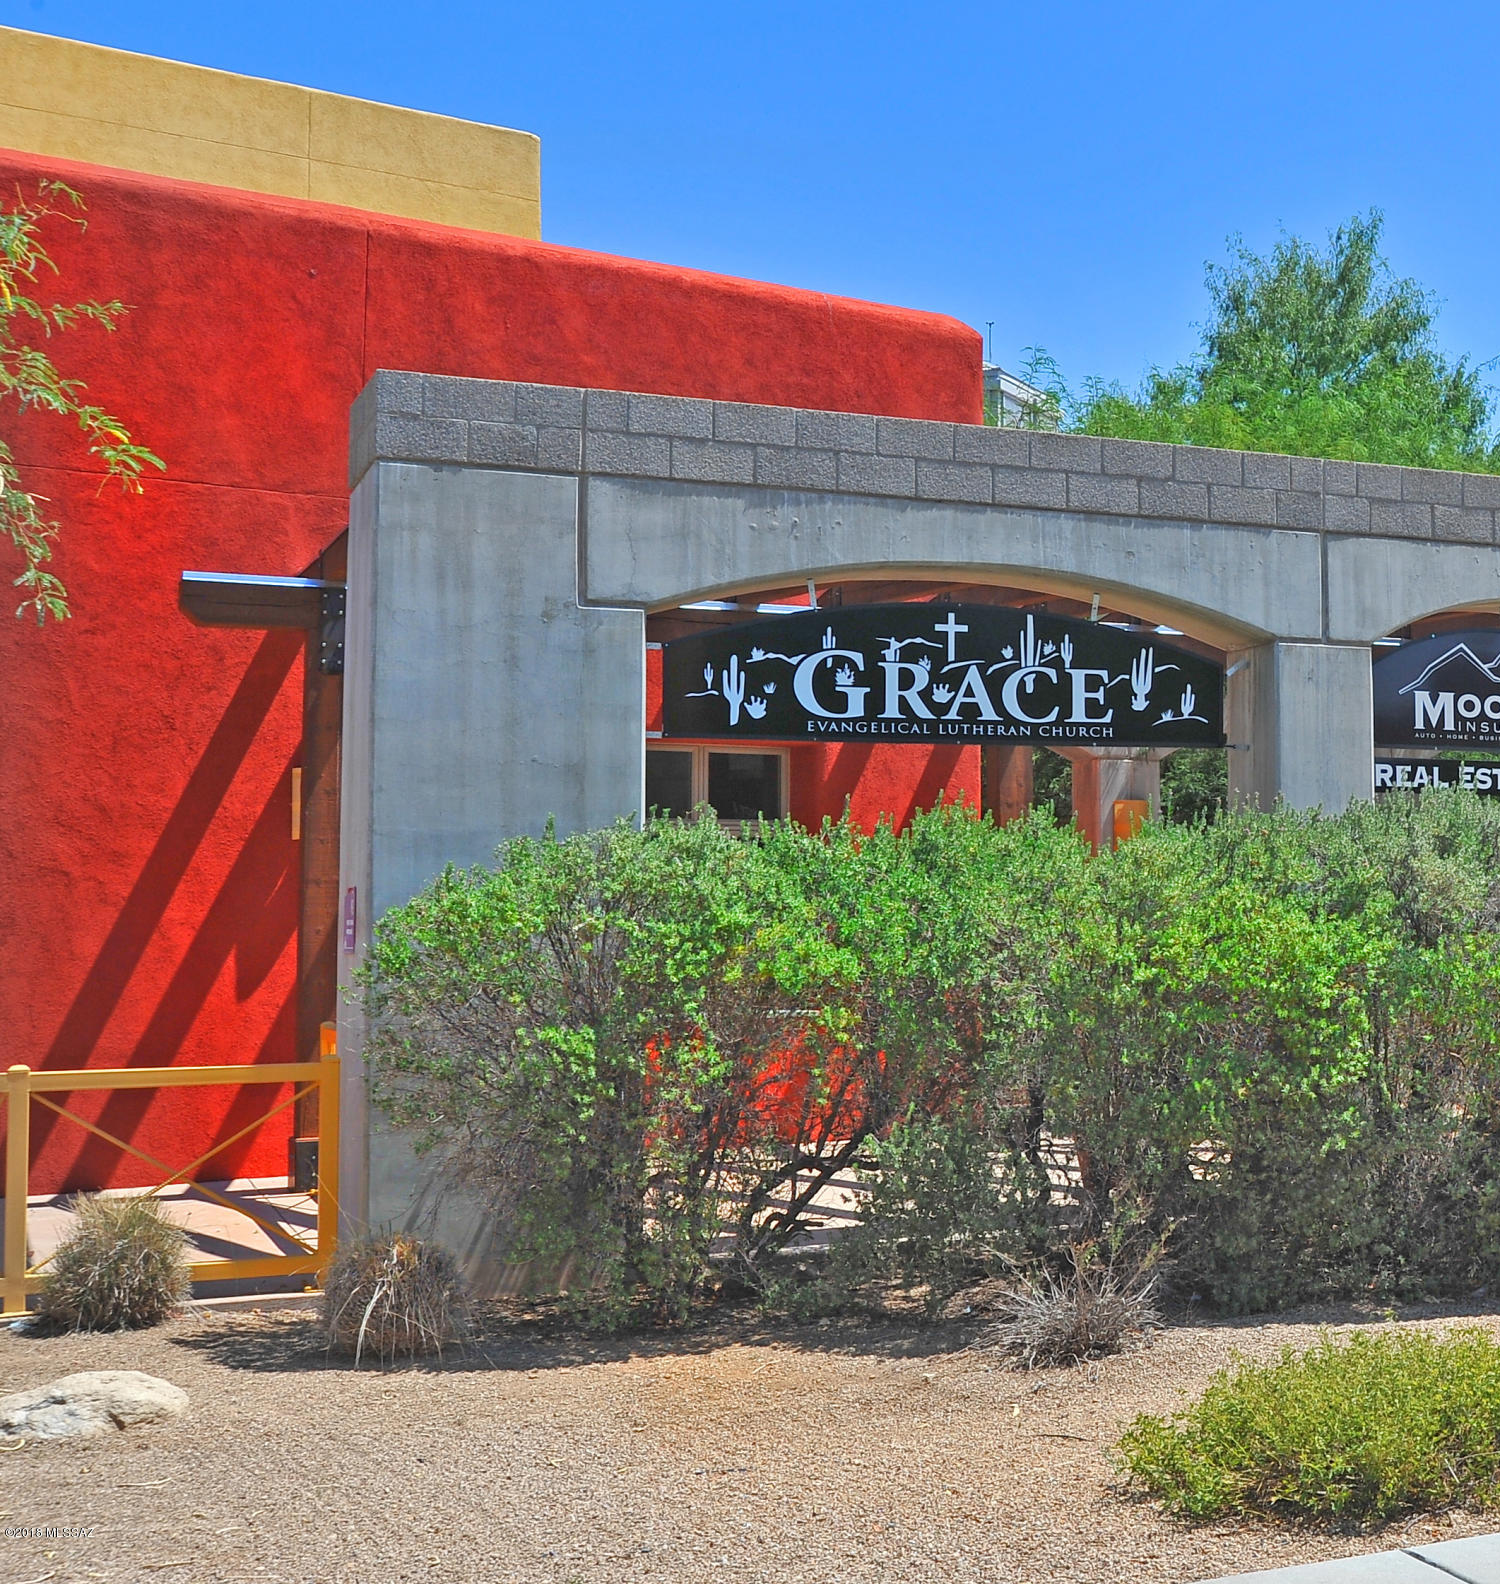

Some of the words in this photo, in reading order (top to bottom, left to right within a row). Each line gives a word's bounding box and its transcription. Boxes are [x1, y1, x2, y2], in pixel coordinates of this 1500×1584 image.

[793, 650, 1114, 724] GRACE
[807, 721, 930, 734] EVANGELICAL
[939, 723, 1032, 737] LUTHERAN
[1039, 726, 1114, 738] CHURCH
[1375, 764, 1449, 788] REAL
